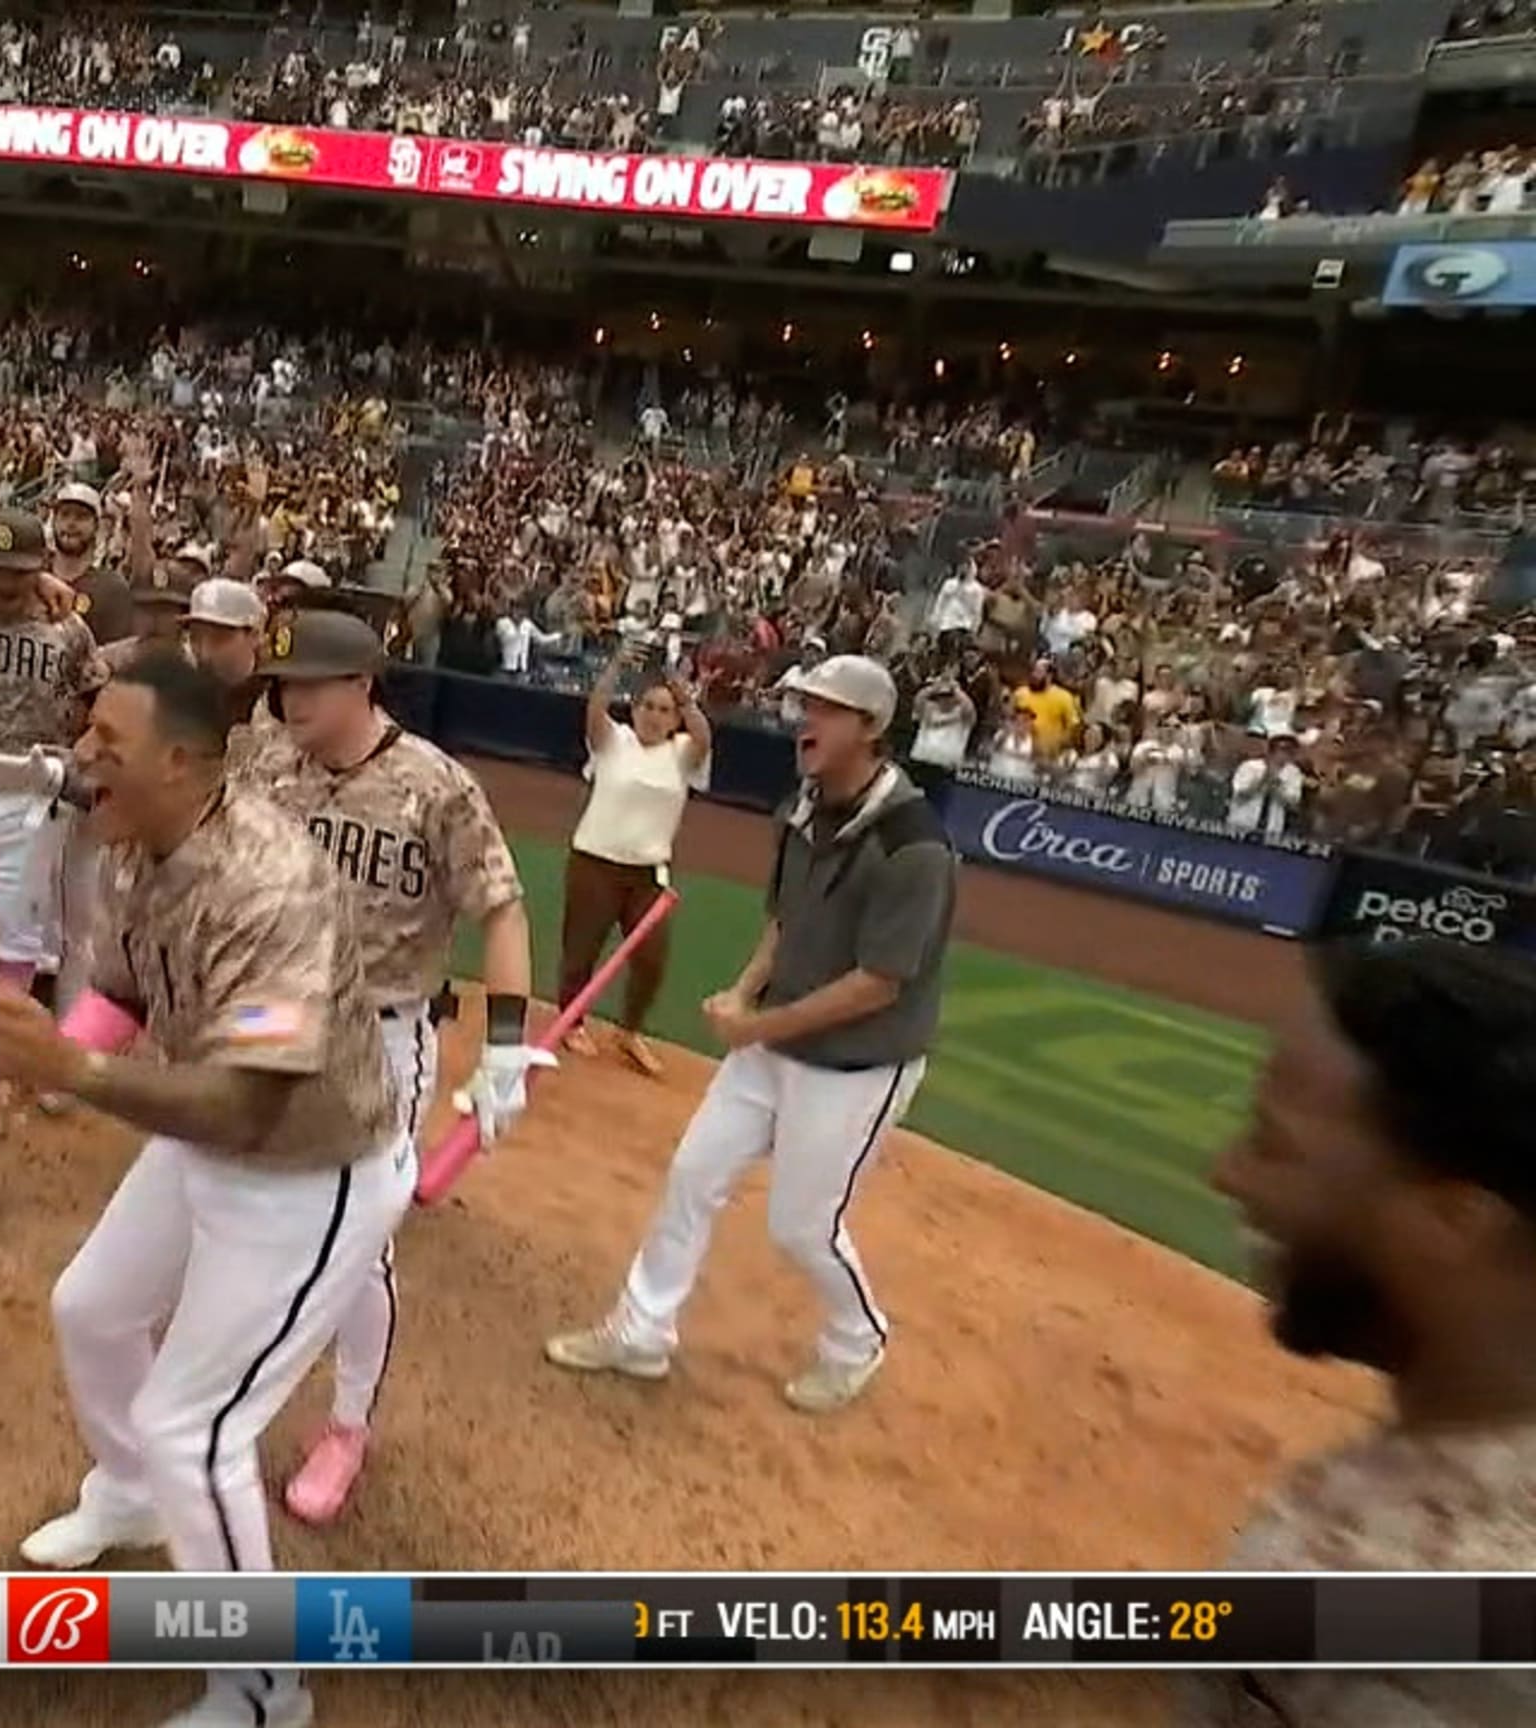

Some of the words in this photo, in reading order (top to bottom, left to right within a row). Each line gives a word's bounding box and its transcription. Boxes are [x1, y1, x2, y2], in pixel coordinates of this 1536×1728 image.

[77, 112, 128, 161] ON
[133, 117, 231, 168] OVER
[497, 148, 628, 202] SWING
[633, 156, 696, 210] ON
[699, 163, 814, 216] OVER
[982, 799, 1134, 872] Circa
[1157, 857, 1262, 901] SPORTS
[1355, 890, 1495, 942] petco
